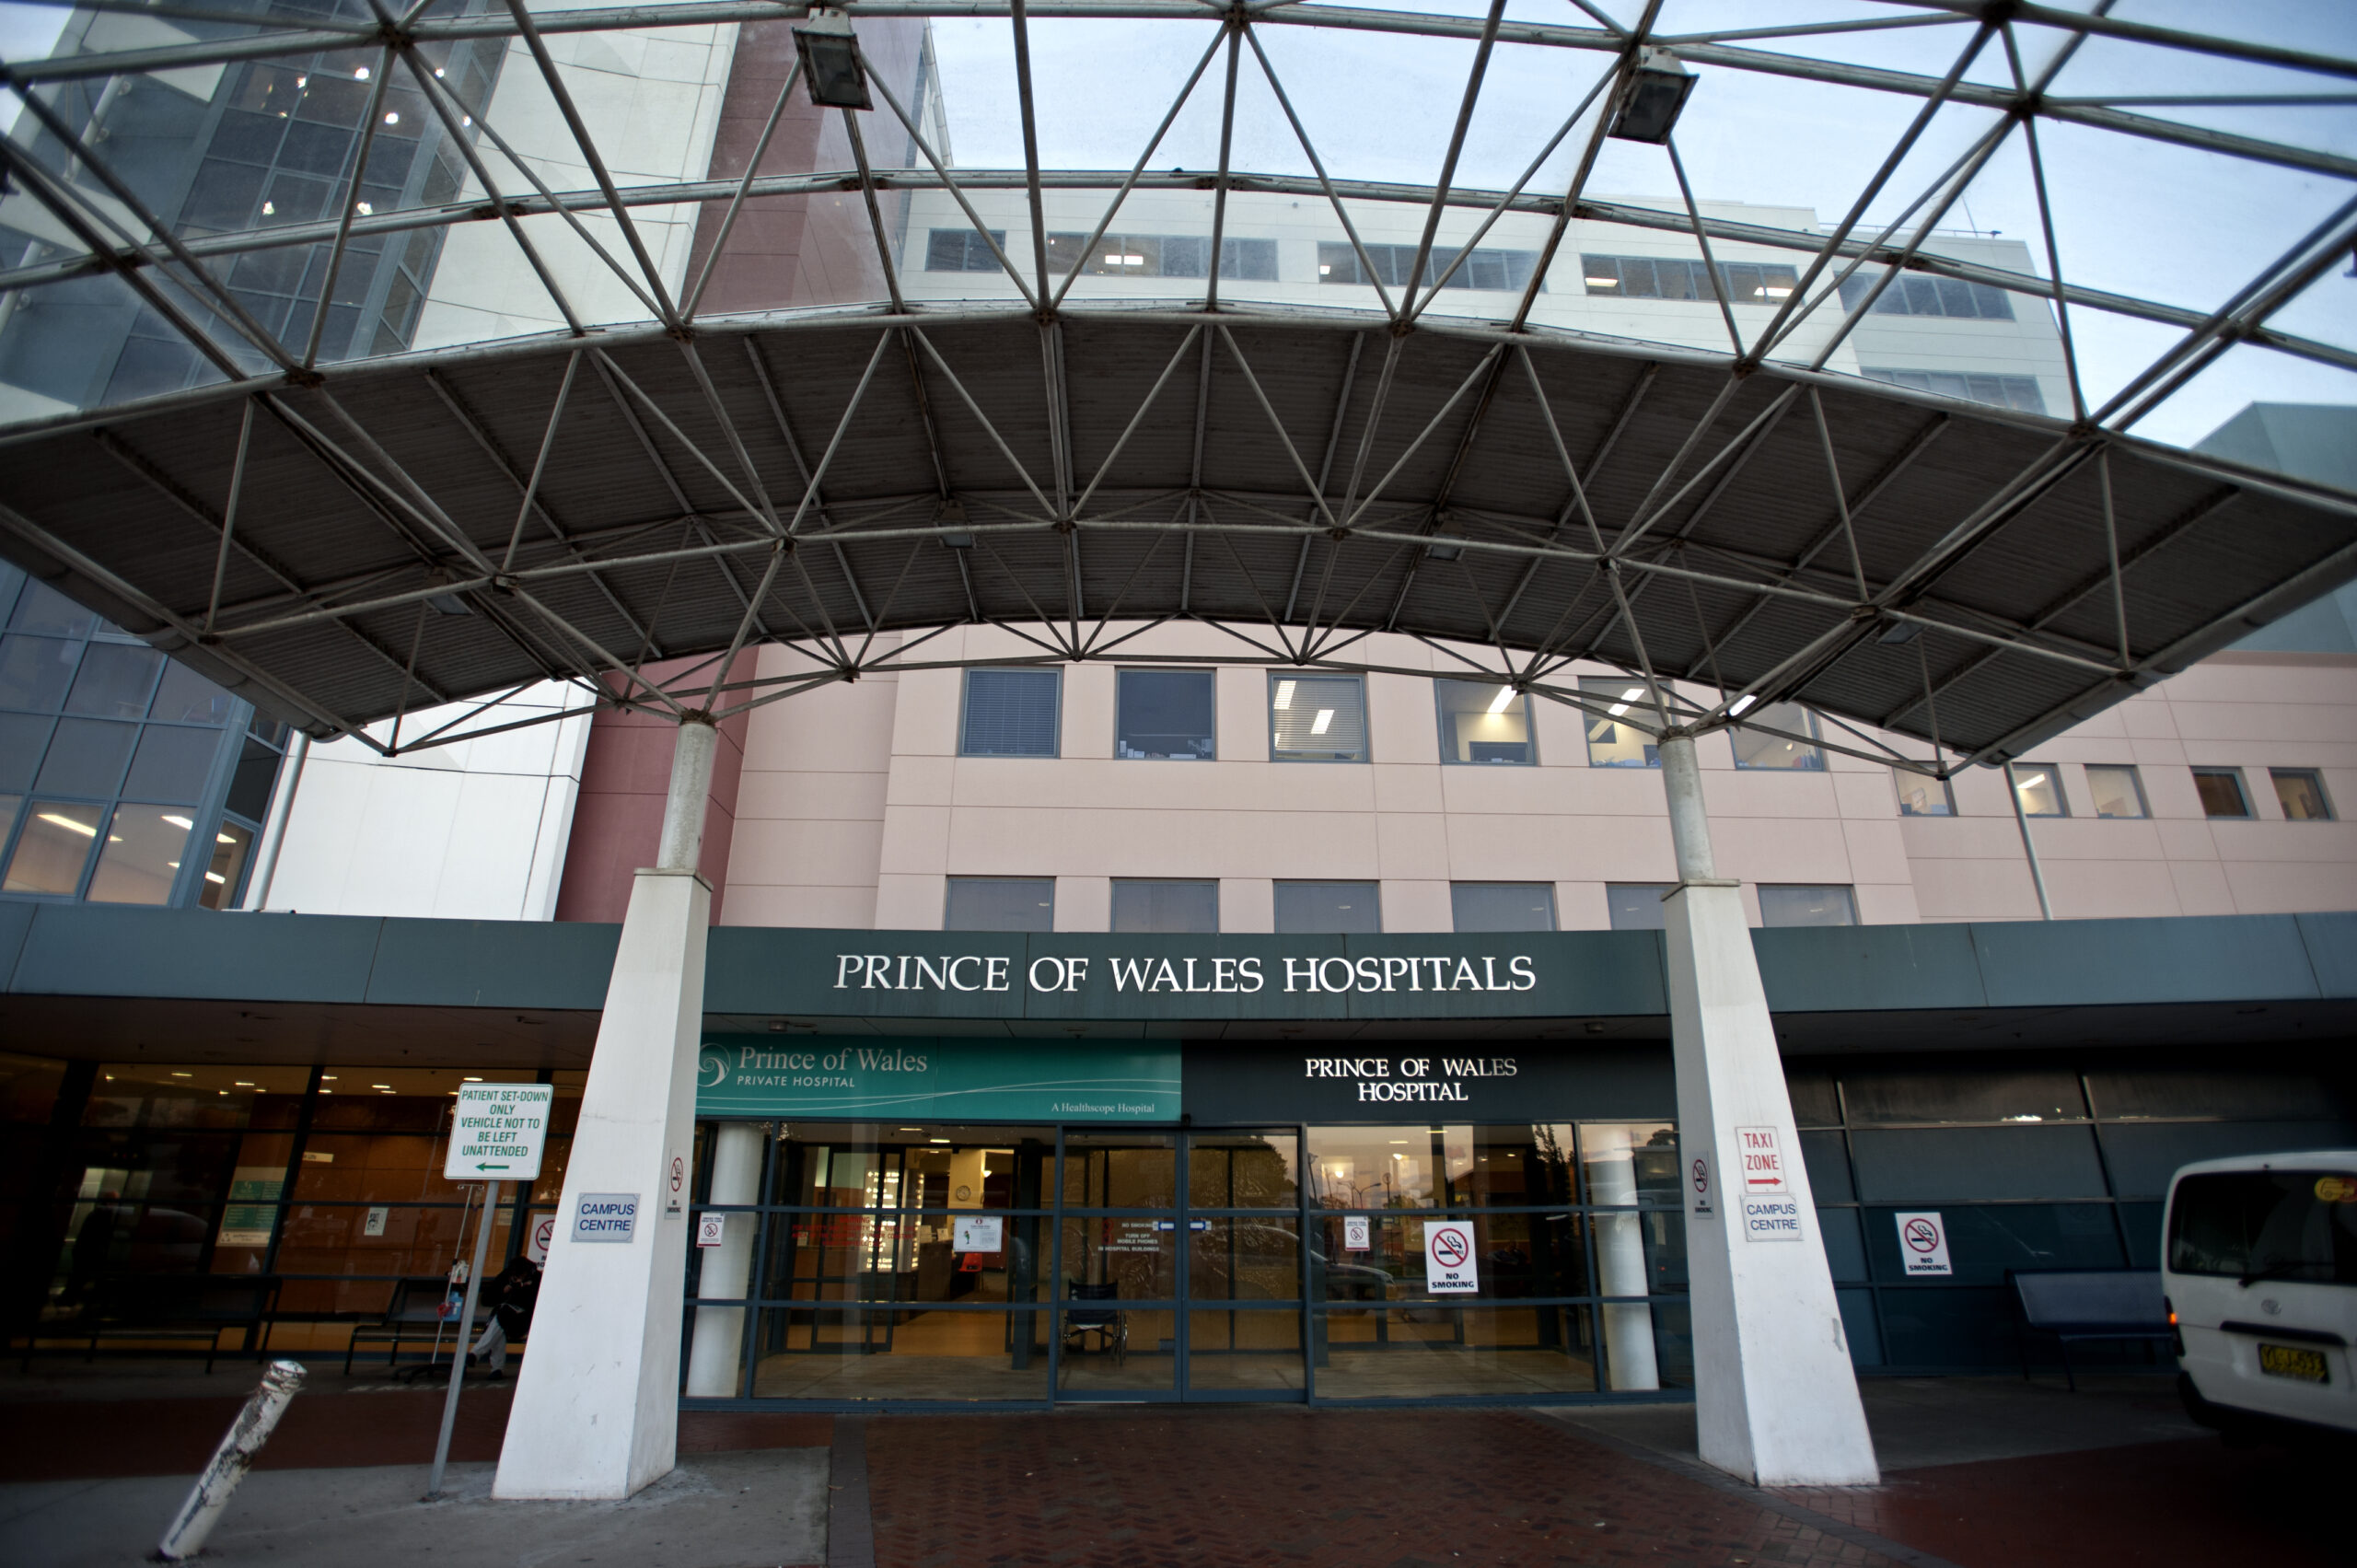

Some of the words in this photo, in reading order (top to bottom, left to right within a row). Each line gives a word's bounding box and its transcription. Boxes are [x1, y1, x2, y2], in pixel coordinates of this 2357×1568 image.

[832, 955, 1010, 992] PRINCE
[1028, 957, 1088, 993] OF
[1109, 957, 1264, 993] WALES
[1283, 956, 1537, 993] HOSPITALS
[737, 1046, 815, 1070] Prince
[822, 1047, 853, 1071] of
[857, 1048, 928, 1073] Wales
[1305, 1058, 1389, 1077] PRINCE
[1400, 1058, 1430, 1077] OF
[1442, 1058, 1517, 1076] WALES
[737, 1075, 787, 1086] PRIVATE
[793, 1076, 855, 1088] HOSPITAL
[461, 1090, 499, 1101] PATIENT
[501, 1090, 549, 1102] SET-DOWN
[1358, 1082, 1469, 1101] HOSPITAL
[490, 1104, 516, 1115] ONLY
[1051, 1103, 1059, 1112] A
[1062, 1103, 1115, 1115] Healthscope
[1118, 1103, 1155, 1115] Hospital
[461, 1117, 503, 1128] VEHICLE
[505, 1118, 525, 1129] NOT
[528, 1118, 540, 1129] TO
[478, 1132, 491, 1143] BE
[493, 1132, 517, 1143] LEFT
[1744, 1132, 1773, 1148] TAXI
[462, 1144, 528, 1156] UNATTENDED
[1746, 1155, 1780, 1170] ZONE
[581, 1203, 634, 1215] CAMPUS
[1747, 1204, 1796, 1215] CAMPUS
[579, 1219, 632, 1231] CENTRE
[1750, 1219, 1798, 1231] CENTRE
[1432, 1281, 1475, 1289] SMOKING
